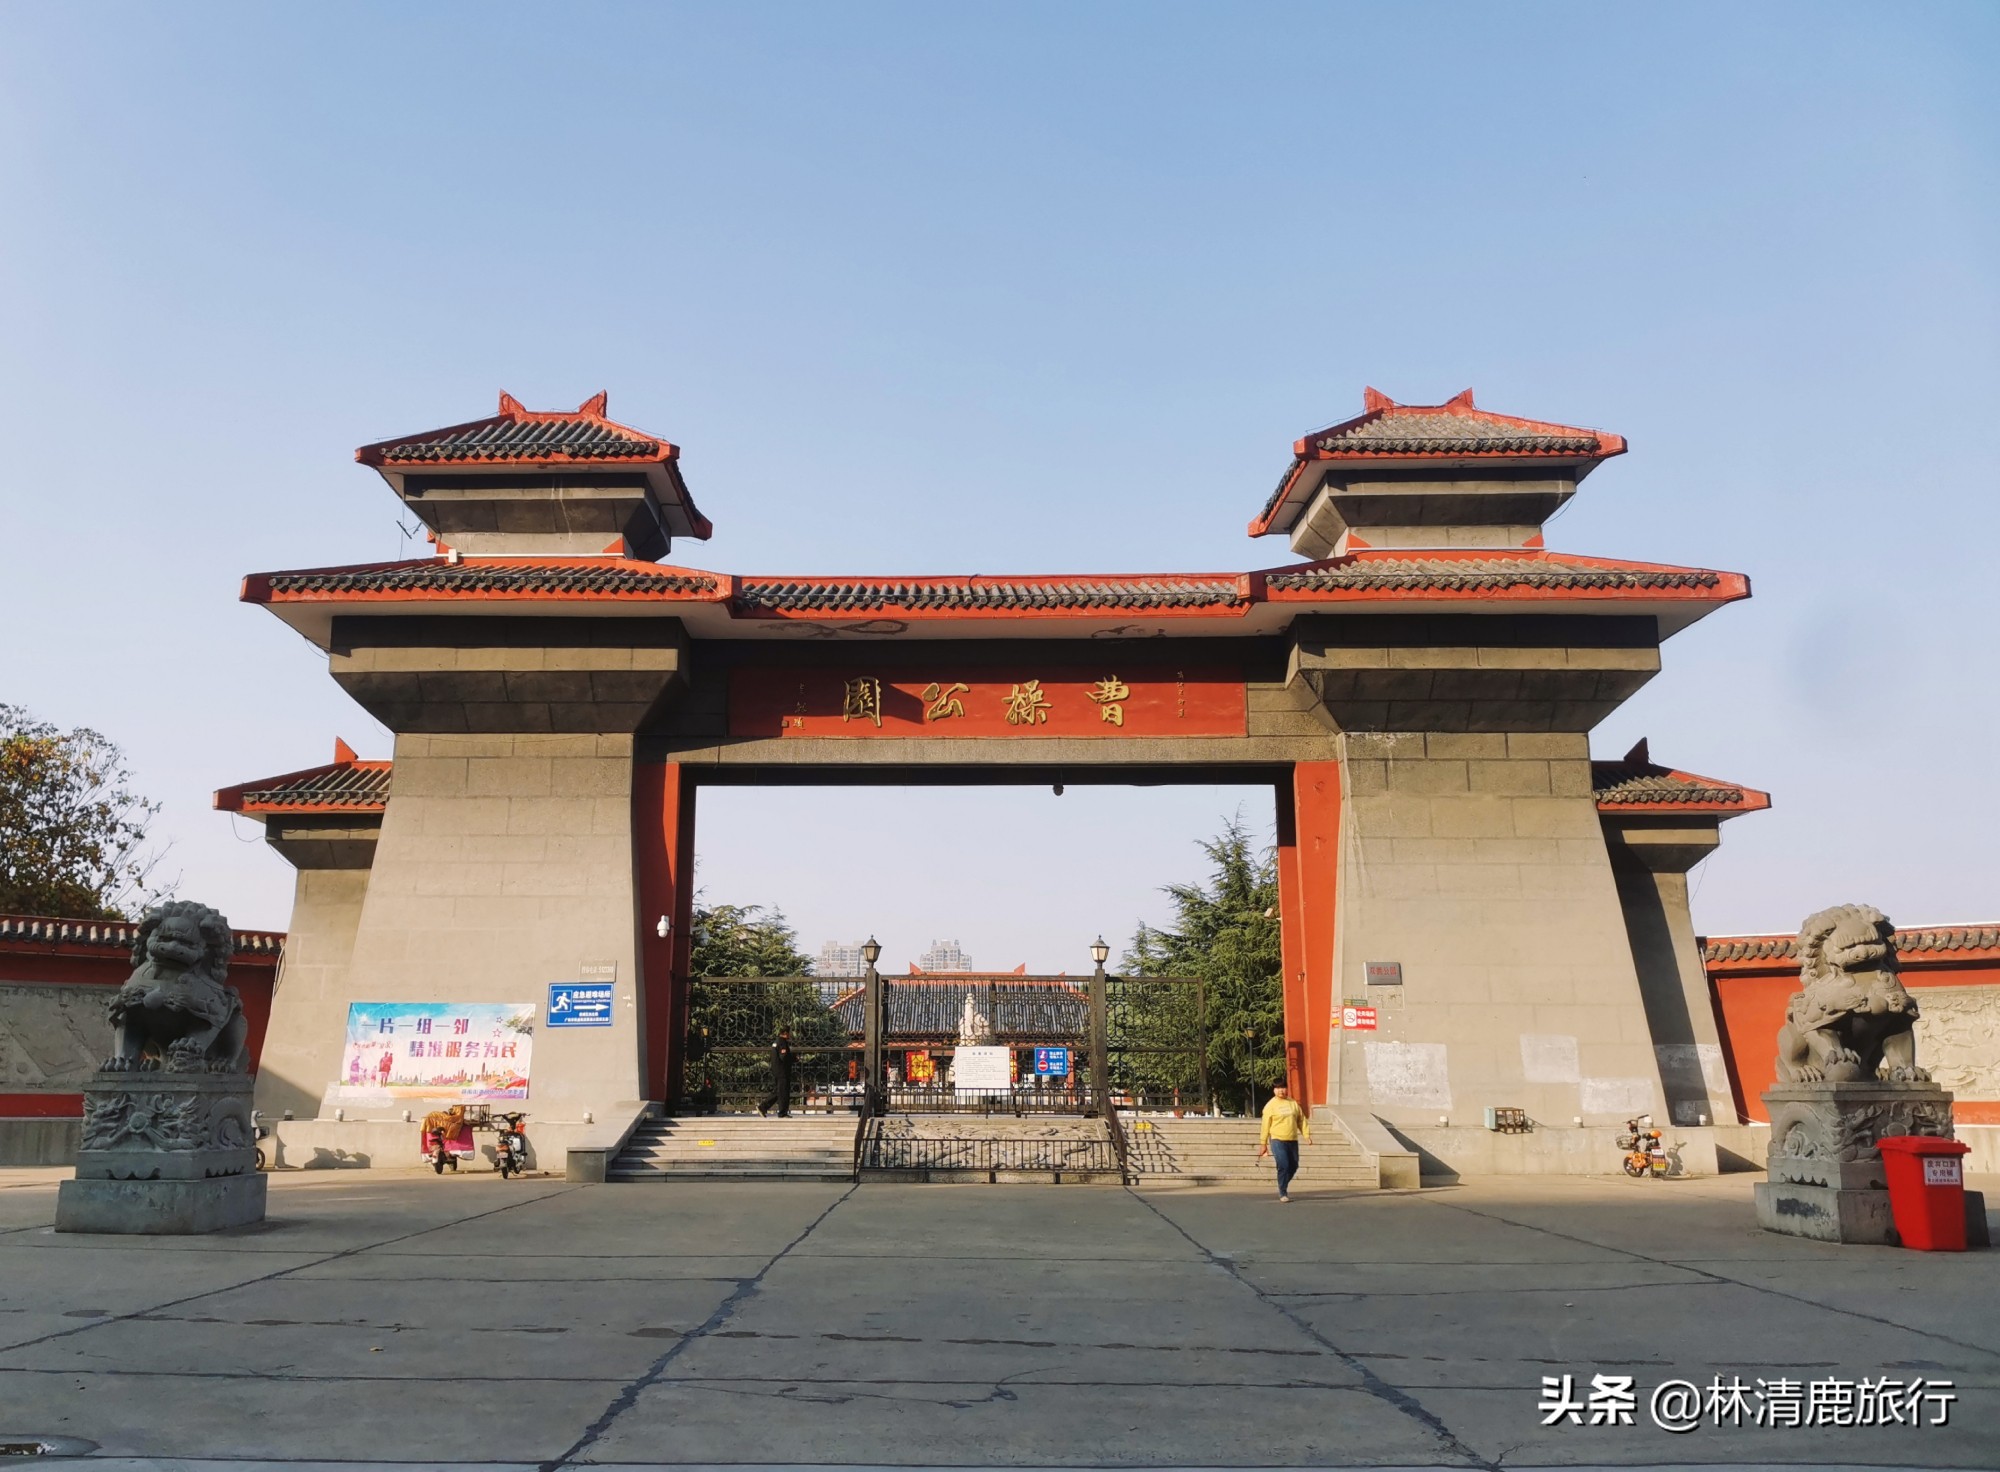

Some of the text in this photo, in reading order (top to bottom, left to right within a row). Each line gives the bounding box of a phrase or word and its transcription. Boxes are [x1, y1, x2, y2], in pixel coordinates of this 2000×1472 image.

[361, 1017, 470, 1035] 一片一组一邻
[408, 1040, 518, 1059] 精准服务为民
